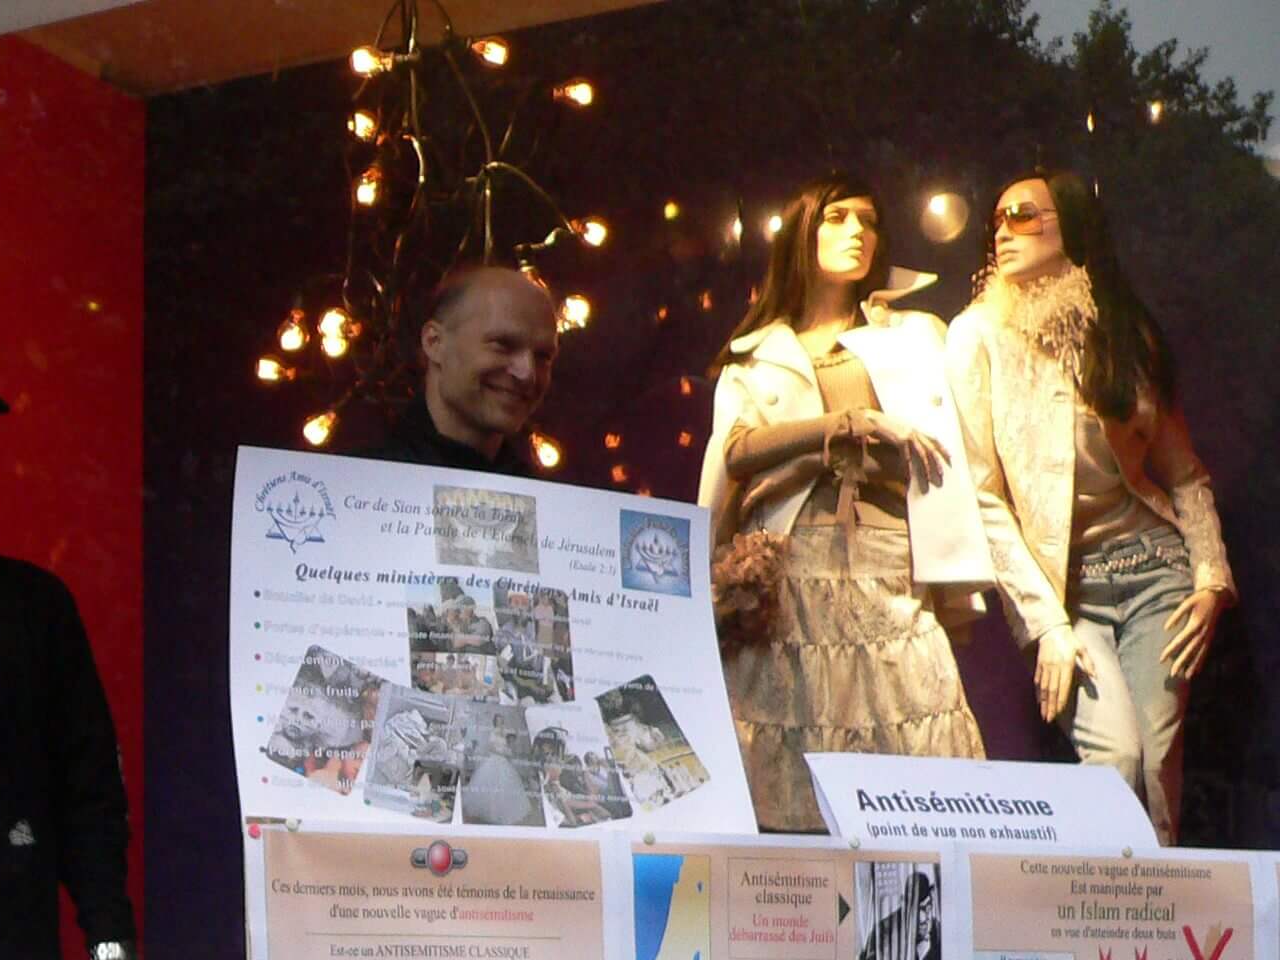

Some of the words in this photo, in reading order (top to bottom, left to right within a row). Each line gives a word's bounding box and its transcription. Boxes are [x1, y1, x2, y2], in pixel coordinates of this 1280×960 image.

[290, 471, 312, 484] Amis
[343, 496, 369, 509] Car
[372, 498, 388, 512] de
[392, 500, 420, 514] Sion
[380, 522, 392, 533] et
[397, 522, 410, 534] la
[541, 536, 554, 549] de
[558, 538, 616, 558] Jérusalem
[296, 564, 370, 584] Quelques
[466, 574, 490, 588] des
[496, 577, 569, 597] Chrétiens
[568, 589, 601, 605] Amis
[606, 593, 659, 612] d'Israël
[856, 788, 1054, 816] Antisémitisme
[866, 822, 907, 839] (point
[911, 824, 928, 836] de
[932, 827, 956, 838] vue
[961, 828, 986, 838] non
[990, 826, 1057, 842] exhaustif)
[1021, 860, 1049, 874] Cette
[1051, 863, 1096, 877] nouvelle
[1098, 865, 1129, 881] vague
[1131, 864, 1211, 880] d'antisémitisme
[741, 871, 829, 889] Antisémitisme
[272, 879, 290, 894] Ces
[292, 880, 336, 896] derniers
[339, 882, 368, 897] mois,
[370, 885, 399, 898] nous
[402, 886, 435, 898] avons
[438, 884, 454, 898] été
[457, 885, 500, 899] témoins
[503, 885, 517, 899] de
[520, 885, 529, 899] la
[532, 888, 595, 900] renaissance
[755, 889, 812, 906] classique
[1071, 882, 1088, 895] Est
[1090, 883, 1144, 898] manipulée
[1146, 885, 1162, 899] par
[330, 906, 359, 920] d'une
[362, 907, 411, 921] nouvelle
[413, 909, 446, 924] vague
[753, 914, 769, 927] Un
[771, 914, 809, 927] monde
[1058, 906, 1075, 920] un
[1080, 902, 1120, 921] Islam
[1125, 903, 1176, 922] radical
[729, 928, 786, 943] débarrassé
[789, 929, 806, 942] des
[808, 929, 834, 944] Juifs
[330, 945, 360, 958] Est-ce
[361, 948, 374, 958] un
[376, 946, 466, 958] ANTISEMITISME
[469, 946, 530, 960] CLASSIQUE
